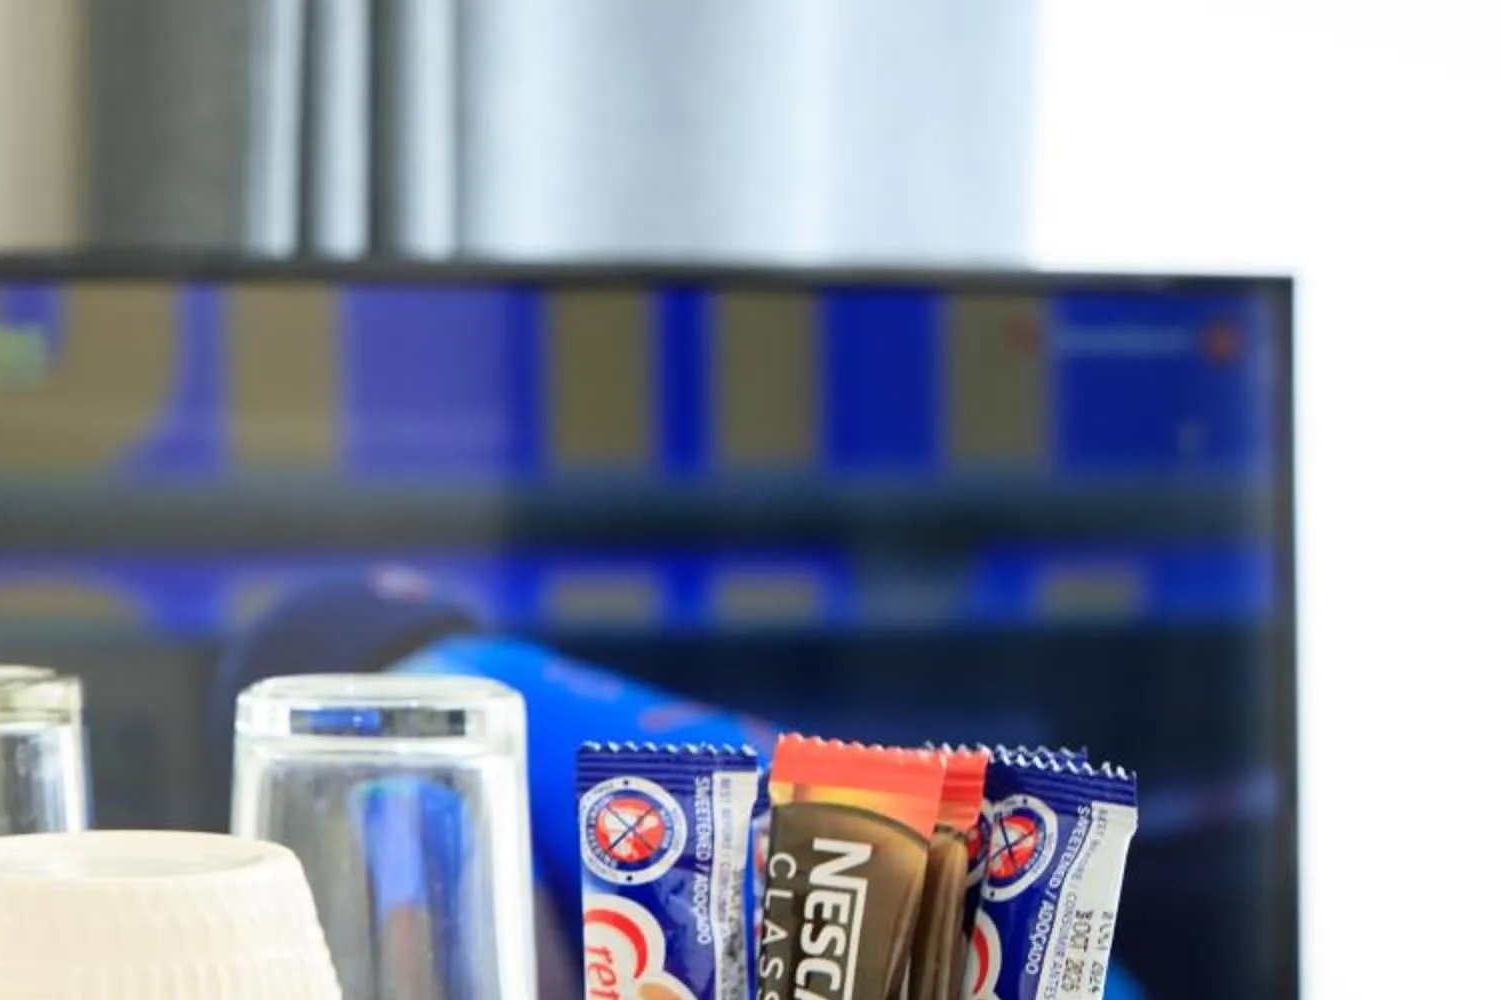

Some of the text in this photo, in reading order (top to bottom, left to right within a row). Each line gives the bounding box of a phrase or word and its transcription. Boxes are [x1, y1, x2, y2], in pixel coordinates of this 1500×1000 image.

[694, 775, 711, 860] SWEETENED
[1048, 804, 1091, 889] SWEETENED
[1025, 899, 1053, 974] ADOÇADO
